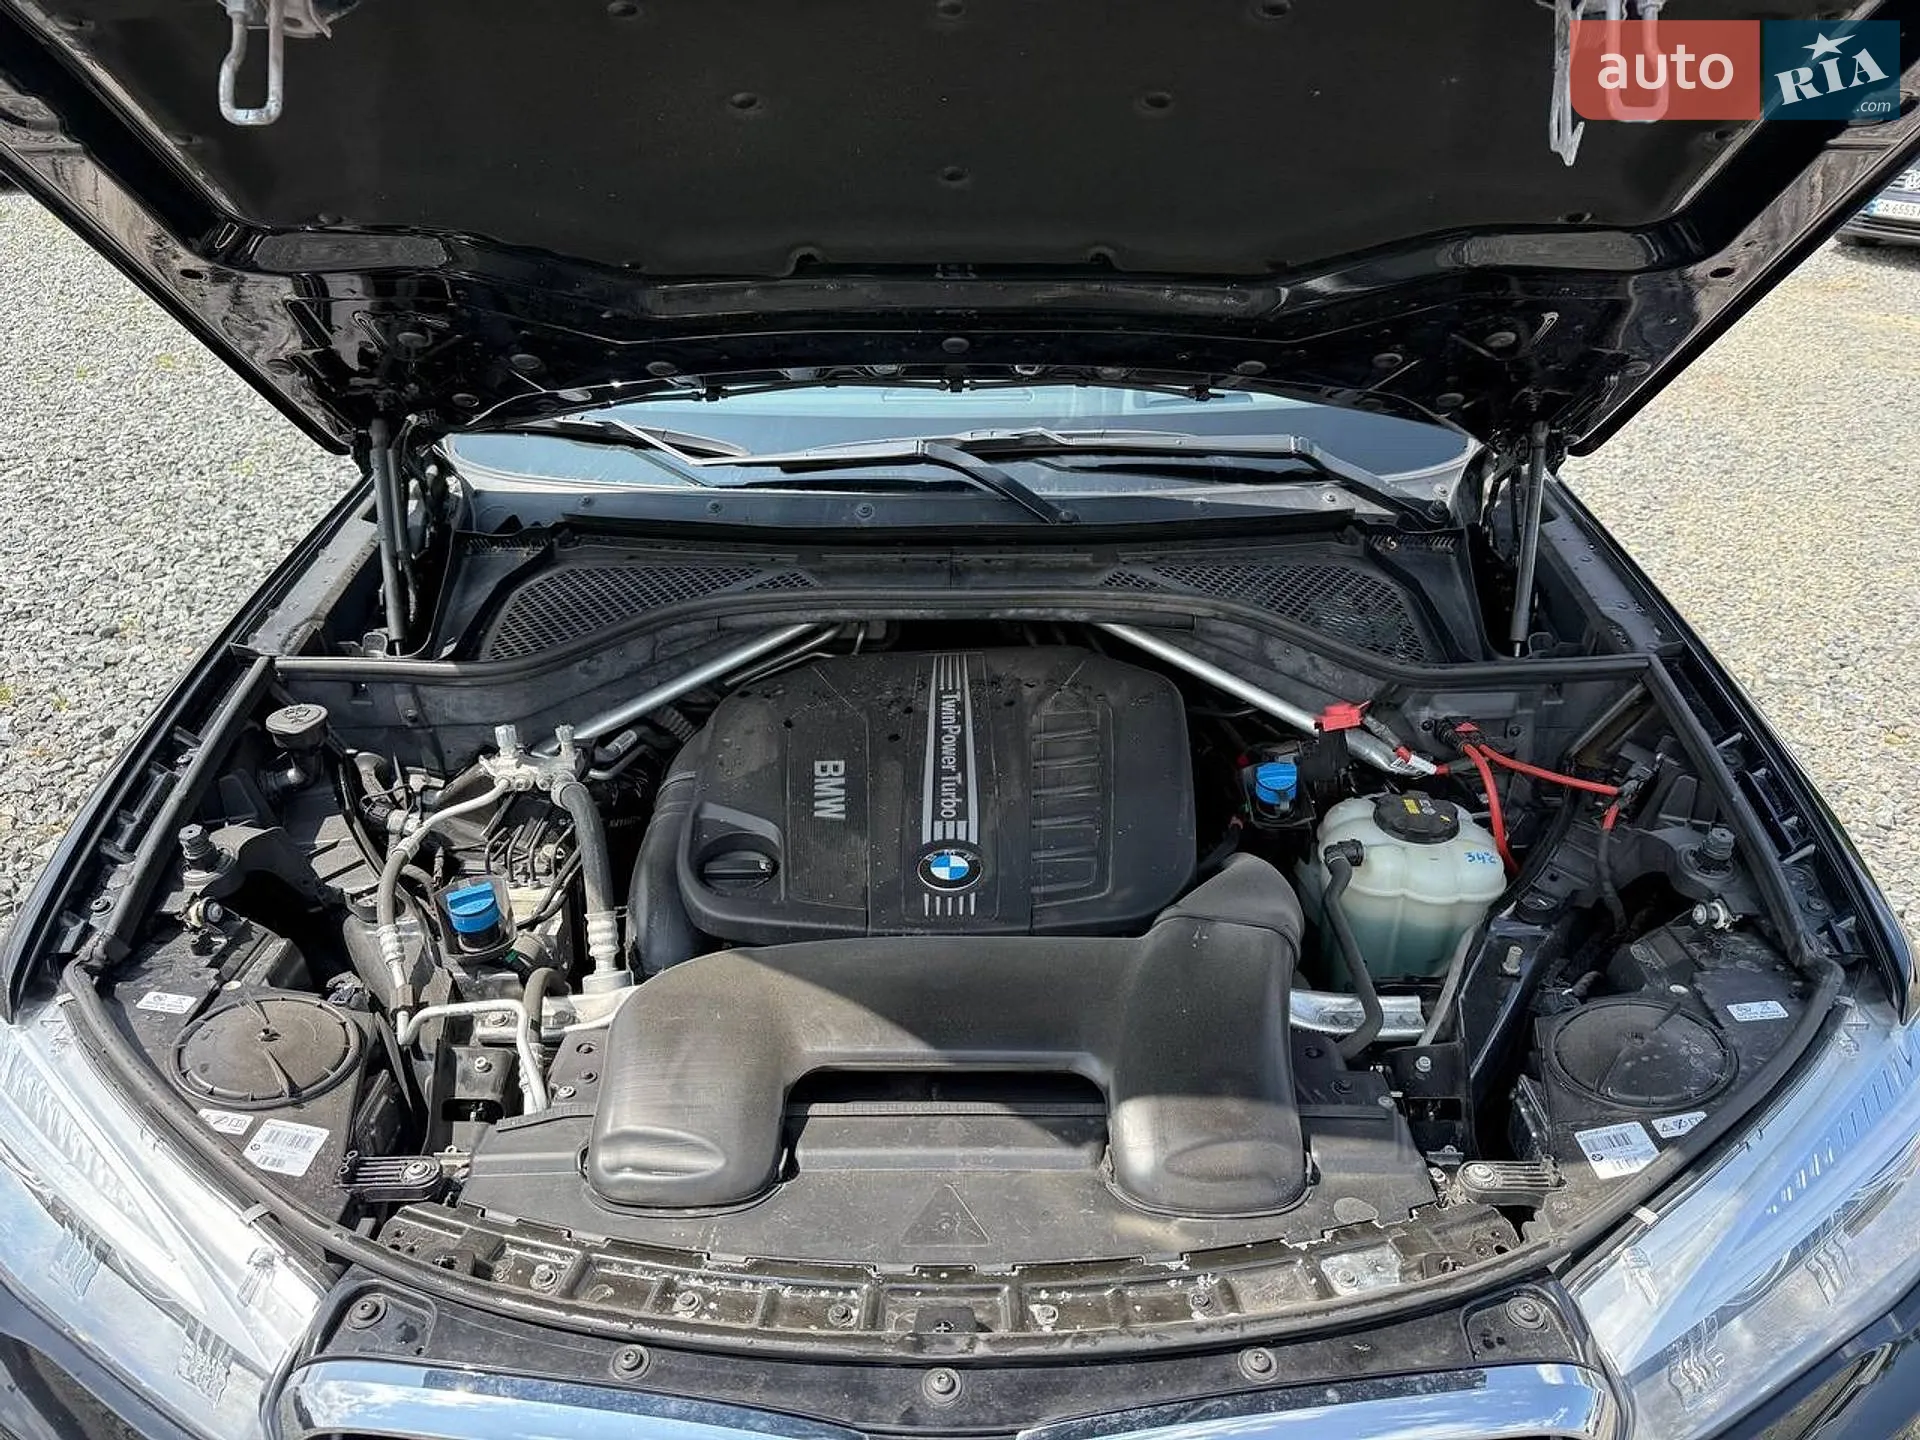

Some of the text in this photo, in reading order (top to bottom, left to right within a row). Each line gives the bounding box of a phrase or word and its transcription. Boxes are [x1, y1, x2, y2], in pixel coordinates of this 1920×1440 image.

[813, 760, 847, 820] BMW
[940, 692, 963, 819] TwinPower Turbo
